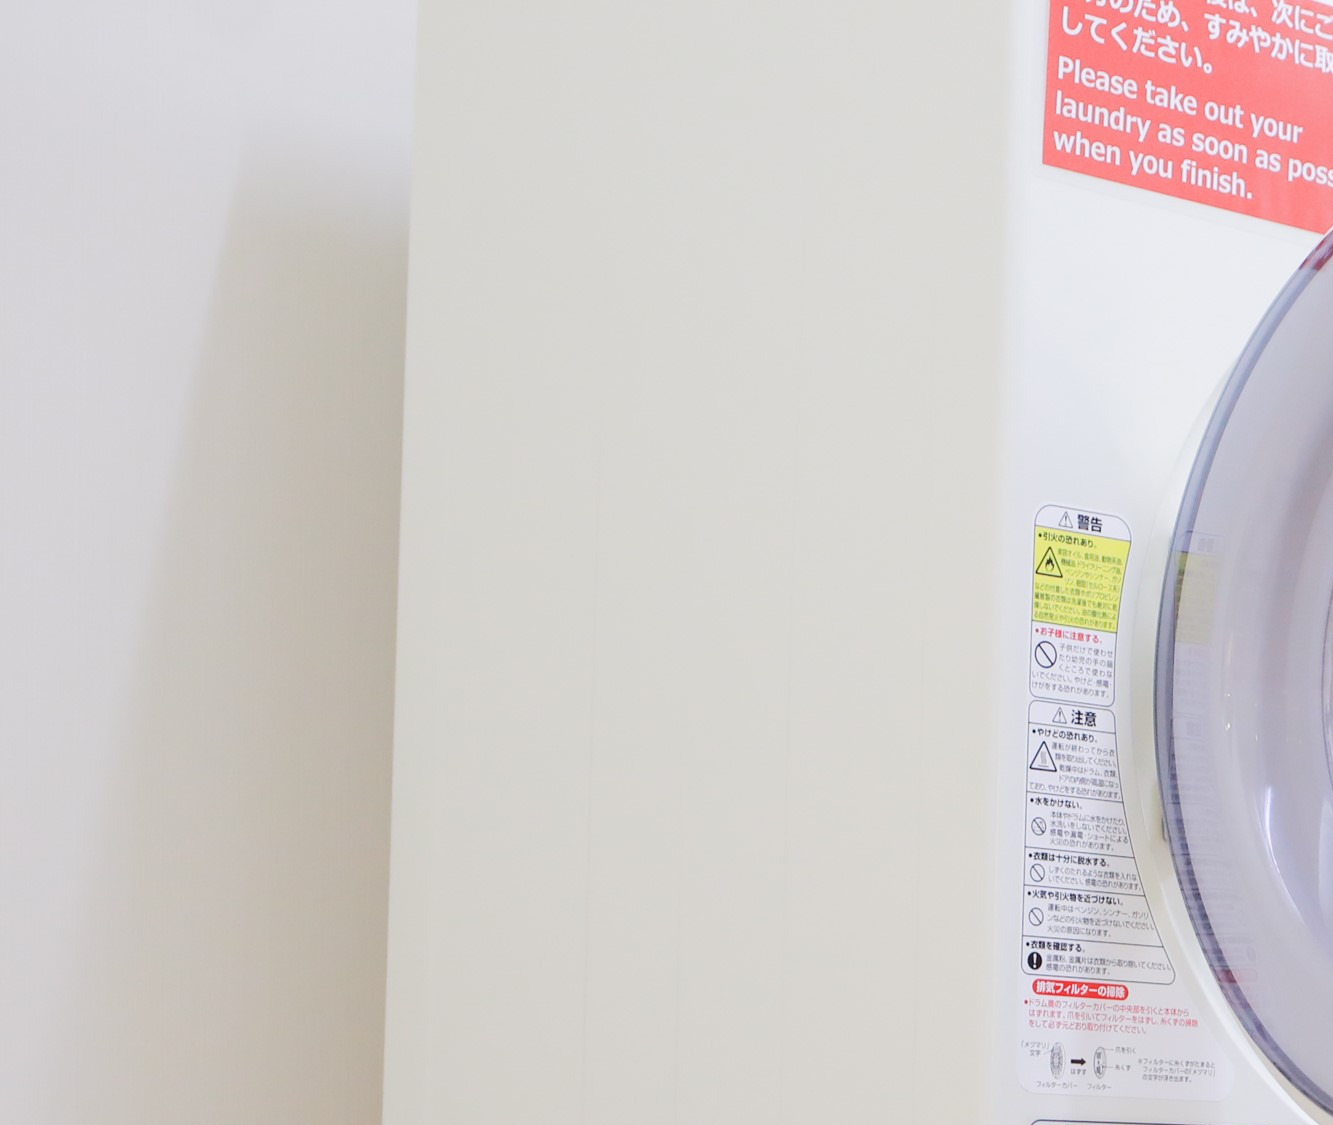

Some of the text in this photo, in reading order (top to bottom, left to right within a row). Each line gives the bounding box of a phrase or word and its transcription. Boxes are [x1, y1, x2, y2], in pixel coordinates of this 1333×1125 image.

[1061, 7, 1213, 74] してください。
[1057, 55, 1303, 144] Please take out your
[1055, 90, 1151, 142] laundry
[1157, 121, 1185, 147] as
[1192, 132, 1248, 164] soon
[1255, 147, 1281, 172] as
[1053, 130, 1253, 200] when you finish.
[1077, 513, 1103, 532] 警告
[1042, 532, 1097, 549] 引火の恐れあり。
[1070, 709, 1097, 727] 注意
[1037, 728, 1098, 743] やけどの恐れあり。
[1034, 796, 1082, 810] 水をかけない。
[1033, 851, 1110, 867] 衣類は十分に脱水する。
[1032, 889, 1124, 906] 火気や引火物を近づけない。
[1030, 940, 1086, 953] 衣類を確認する。
[1036, 981, 1126, 999] 排気フィルターの掃除
